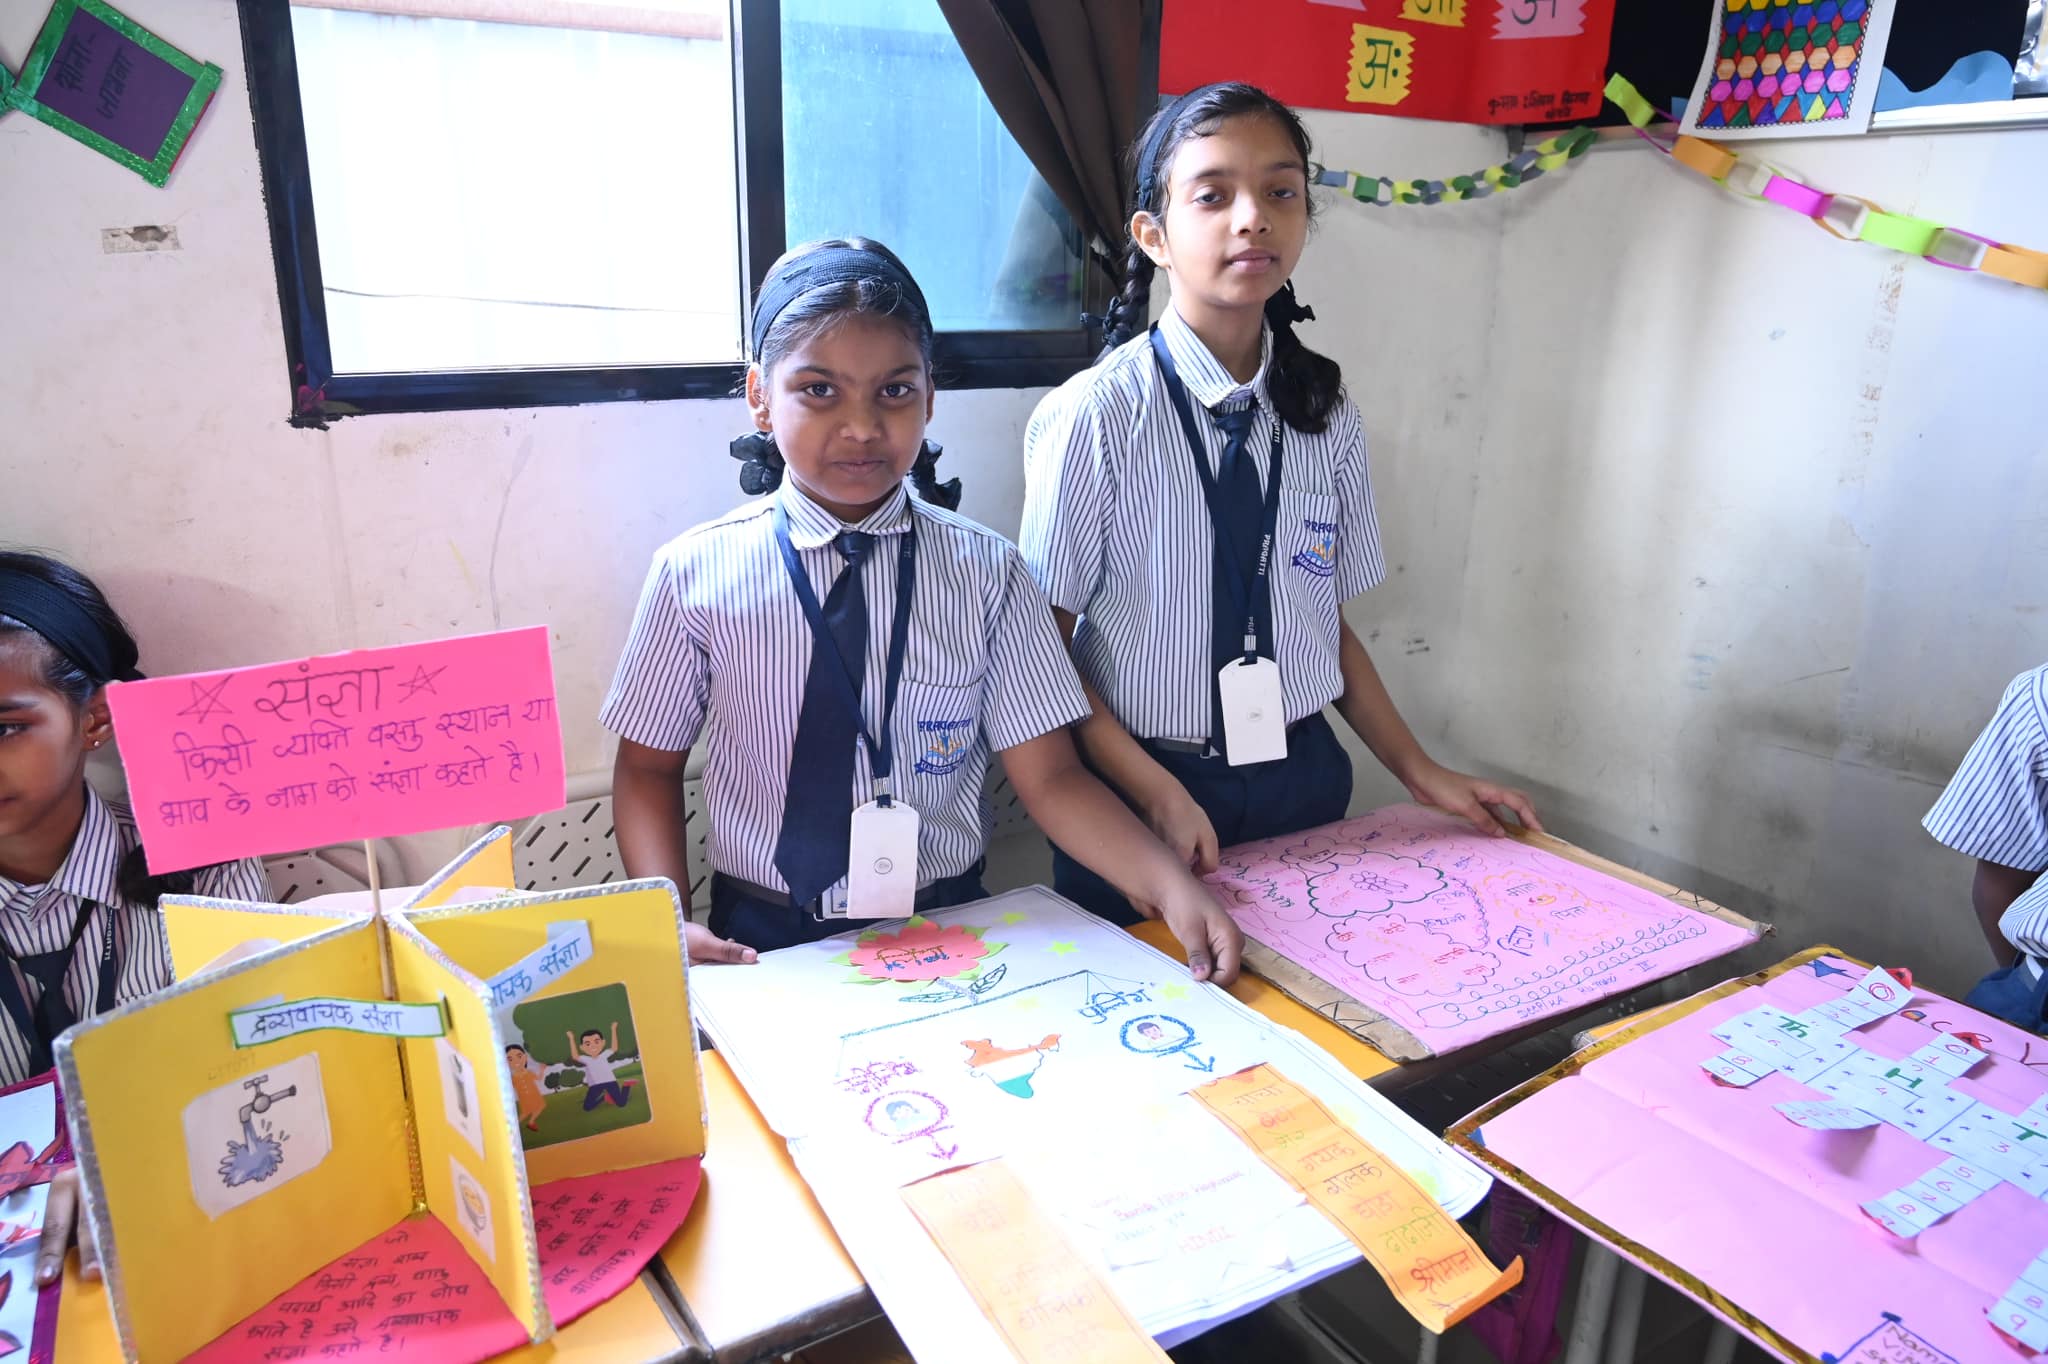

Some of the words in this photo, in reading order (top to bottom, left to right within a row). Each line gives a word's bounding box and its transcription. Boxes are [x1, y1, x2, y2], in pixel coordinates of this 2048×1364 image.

[1358, 37, 1402, 90] अः
[1257, 534, 1271, 576] PRAGATTI
[255, 665, 394, 722] संज्ञा
[173, 724, 256, 782] किसी
[367, 717, 425, 752] वस्तु
[435, 702, 512, 737] स्थान
[522, 697, 555, 722] या
[159, 797, 210, 827] भाव
[219, 782, 251, 816] के
[266, 781, 318, 809] नाम
[326, 762, 359, 801] को
[368, 760, 428, 795] संज्ञा
[434, 745, 488, 788] कहते
[538, 937, 581, 976] संज्ञा
[361, 1003, 405, 1031] संज्ञा
[1779, 1015, 1810, 1039] Th
[1884, 1067, 1924, 1089] H
[2011, 1121, 2048, 1141] T
[1885, 1325, 1950, 1364] Nam
